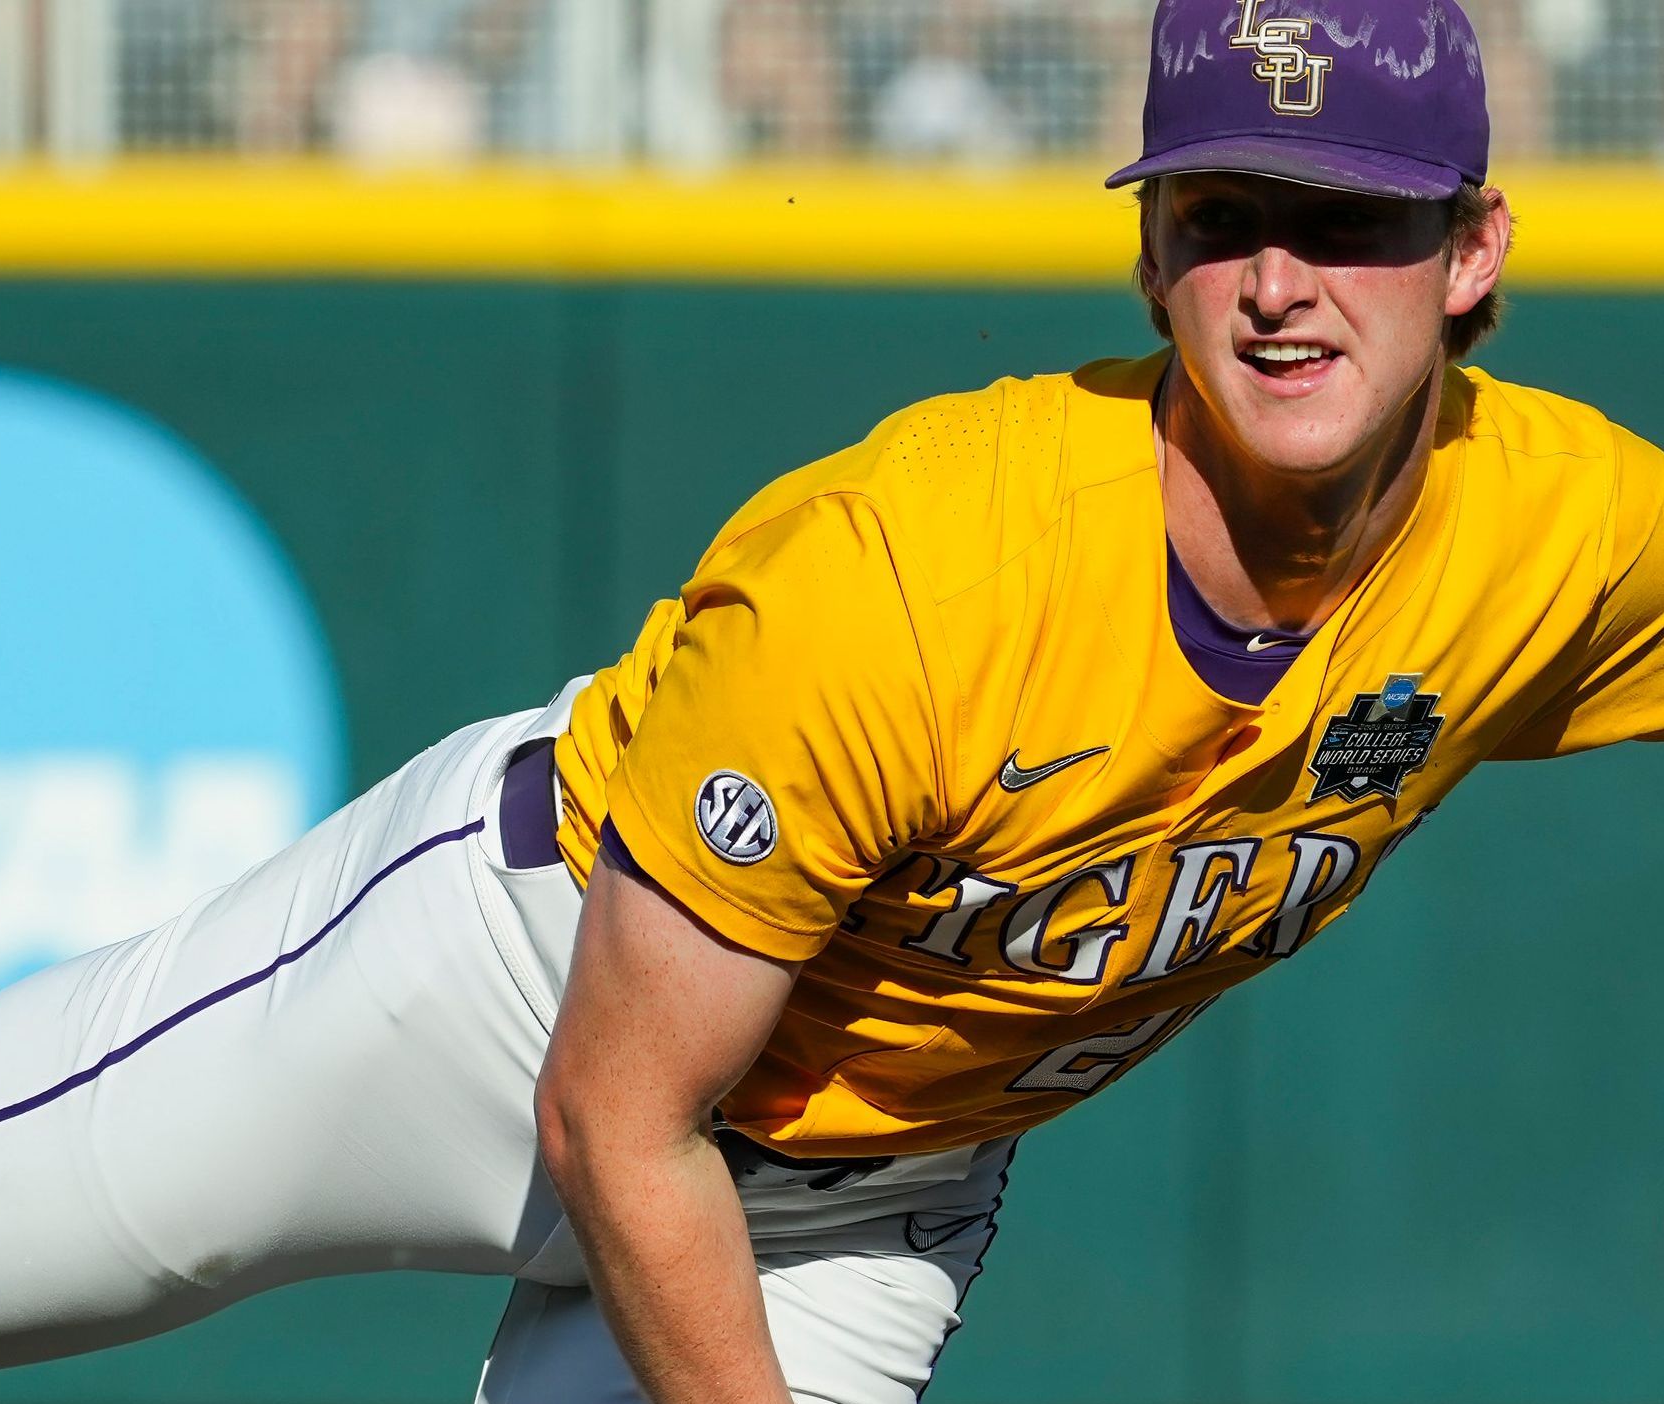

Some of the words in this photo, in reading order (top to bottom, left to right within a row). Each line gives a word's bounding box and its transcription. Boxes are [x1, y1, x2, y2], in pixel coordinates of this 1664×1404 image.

[1229, 0, 1333, 117] LSU
[1317, 750, 1369, 765] WORLD
[1370, 747, 1424, 764] SERIES
[1345, 731, 1412, 747] COLLEGE
[699, 776, 772, 856] SEC
